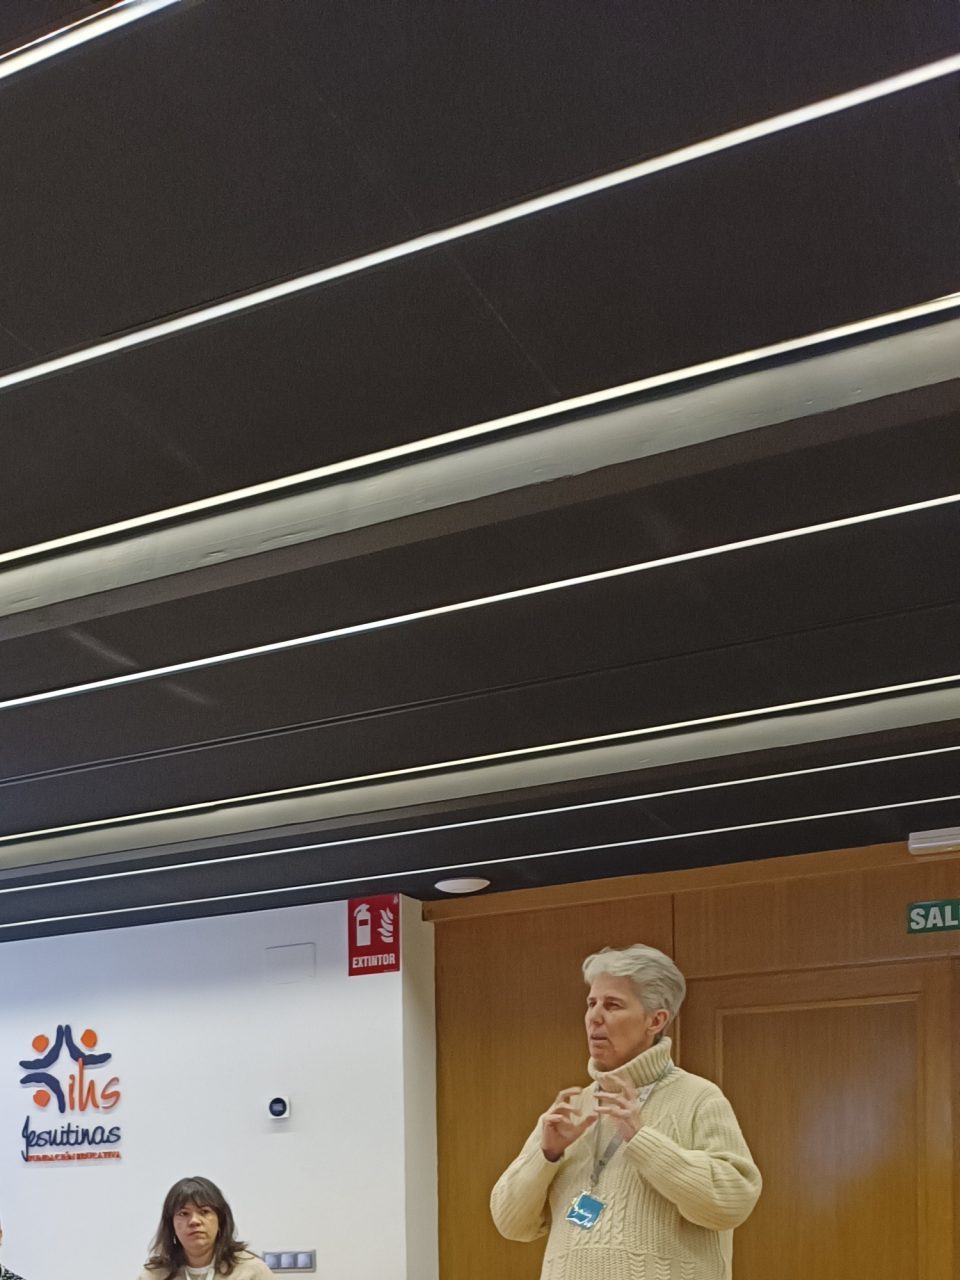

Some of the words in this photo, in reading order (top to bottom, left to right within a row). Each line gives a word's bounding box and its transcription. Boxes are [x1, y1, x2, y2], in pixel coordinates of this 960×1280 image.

[910, 905, 960, 930] SAL
[353, 953, 395, 968] EXTINTOR
[21, 1115, 122, 1162] Jesuitinas
[76, 1151, 121, 1160] EDUCATIVA
